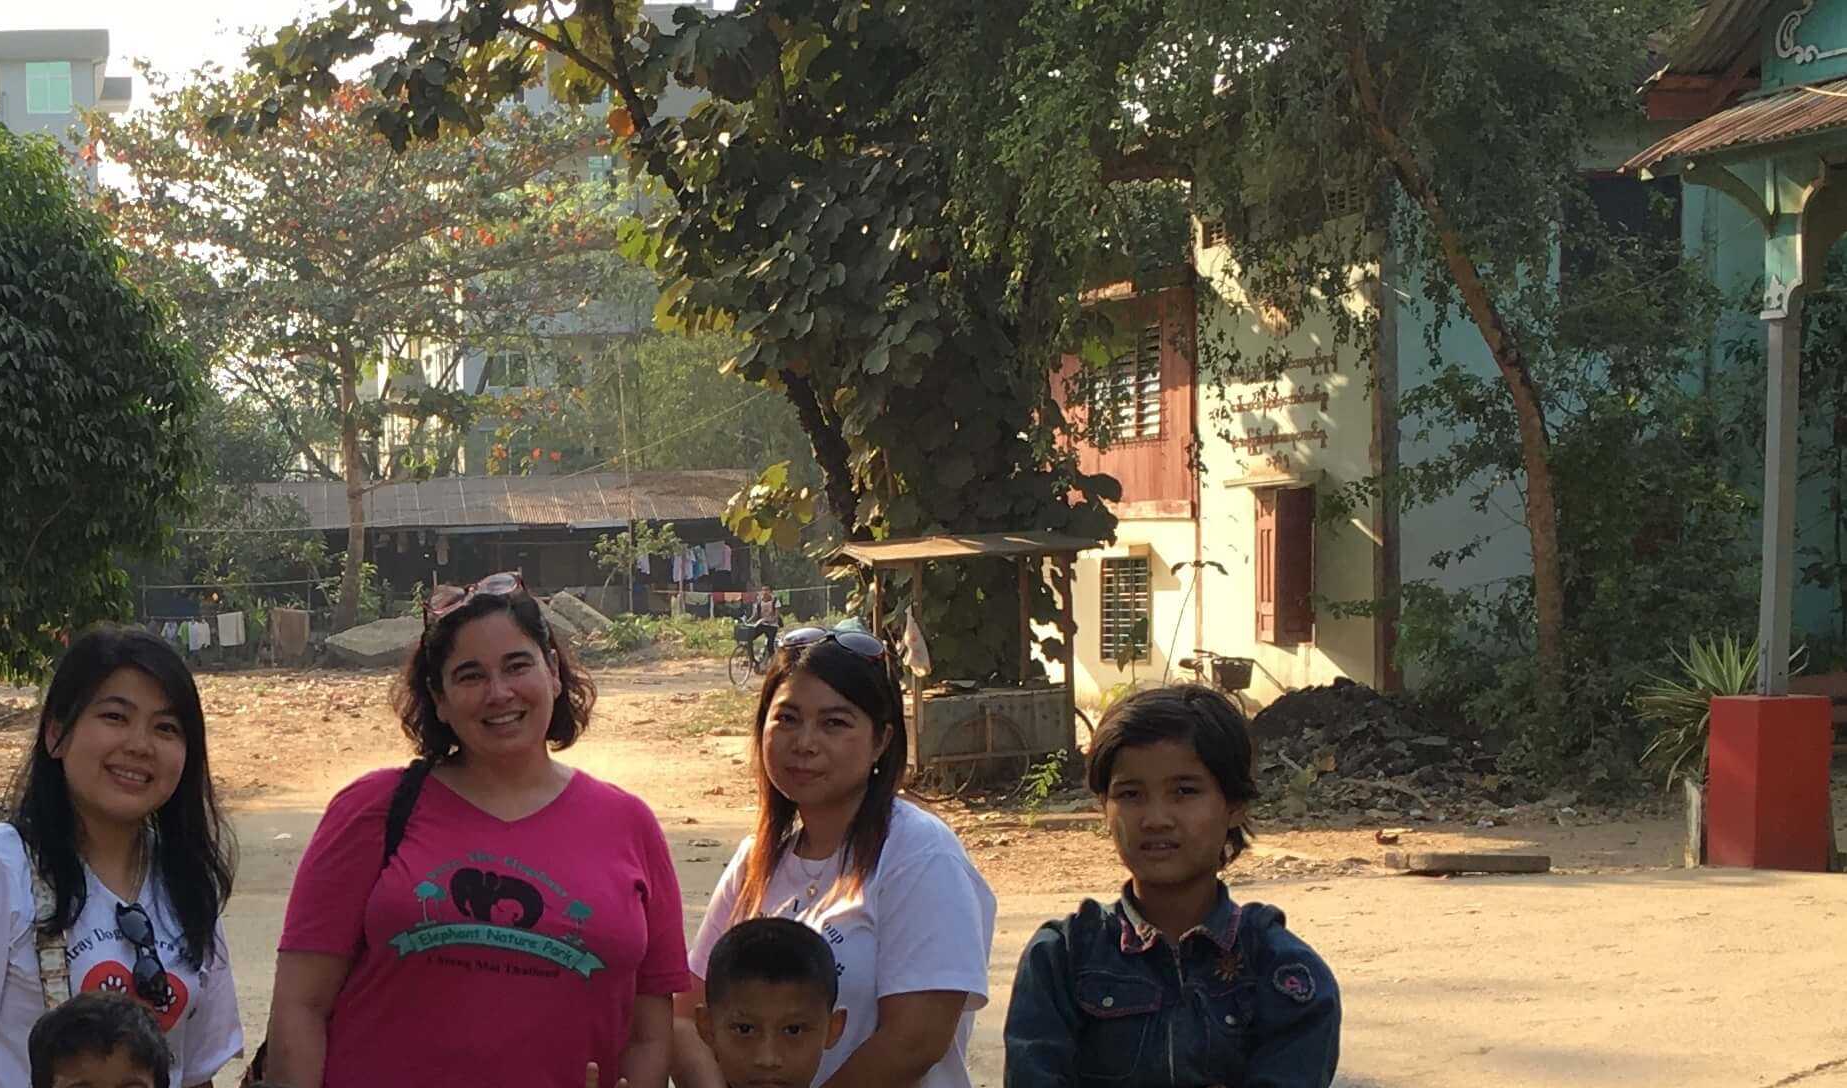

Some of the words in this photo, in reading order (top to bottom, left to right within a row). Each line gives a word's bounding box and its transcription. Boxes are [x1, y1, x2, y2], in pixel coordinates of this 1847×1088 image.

[93, 927, 123, 942] Dog
[417, 926, 481, 946] Elephant
[486, 928, 539, 948] Nature
[542, 941, 573, 963] Park
